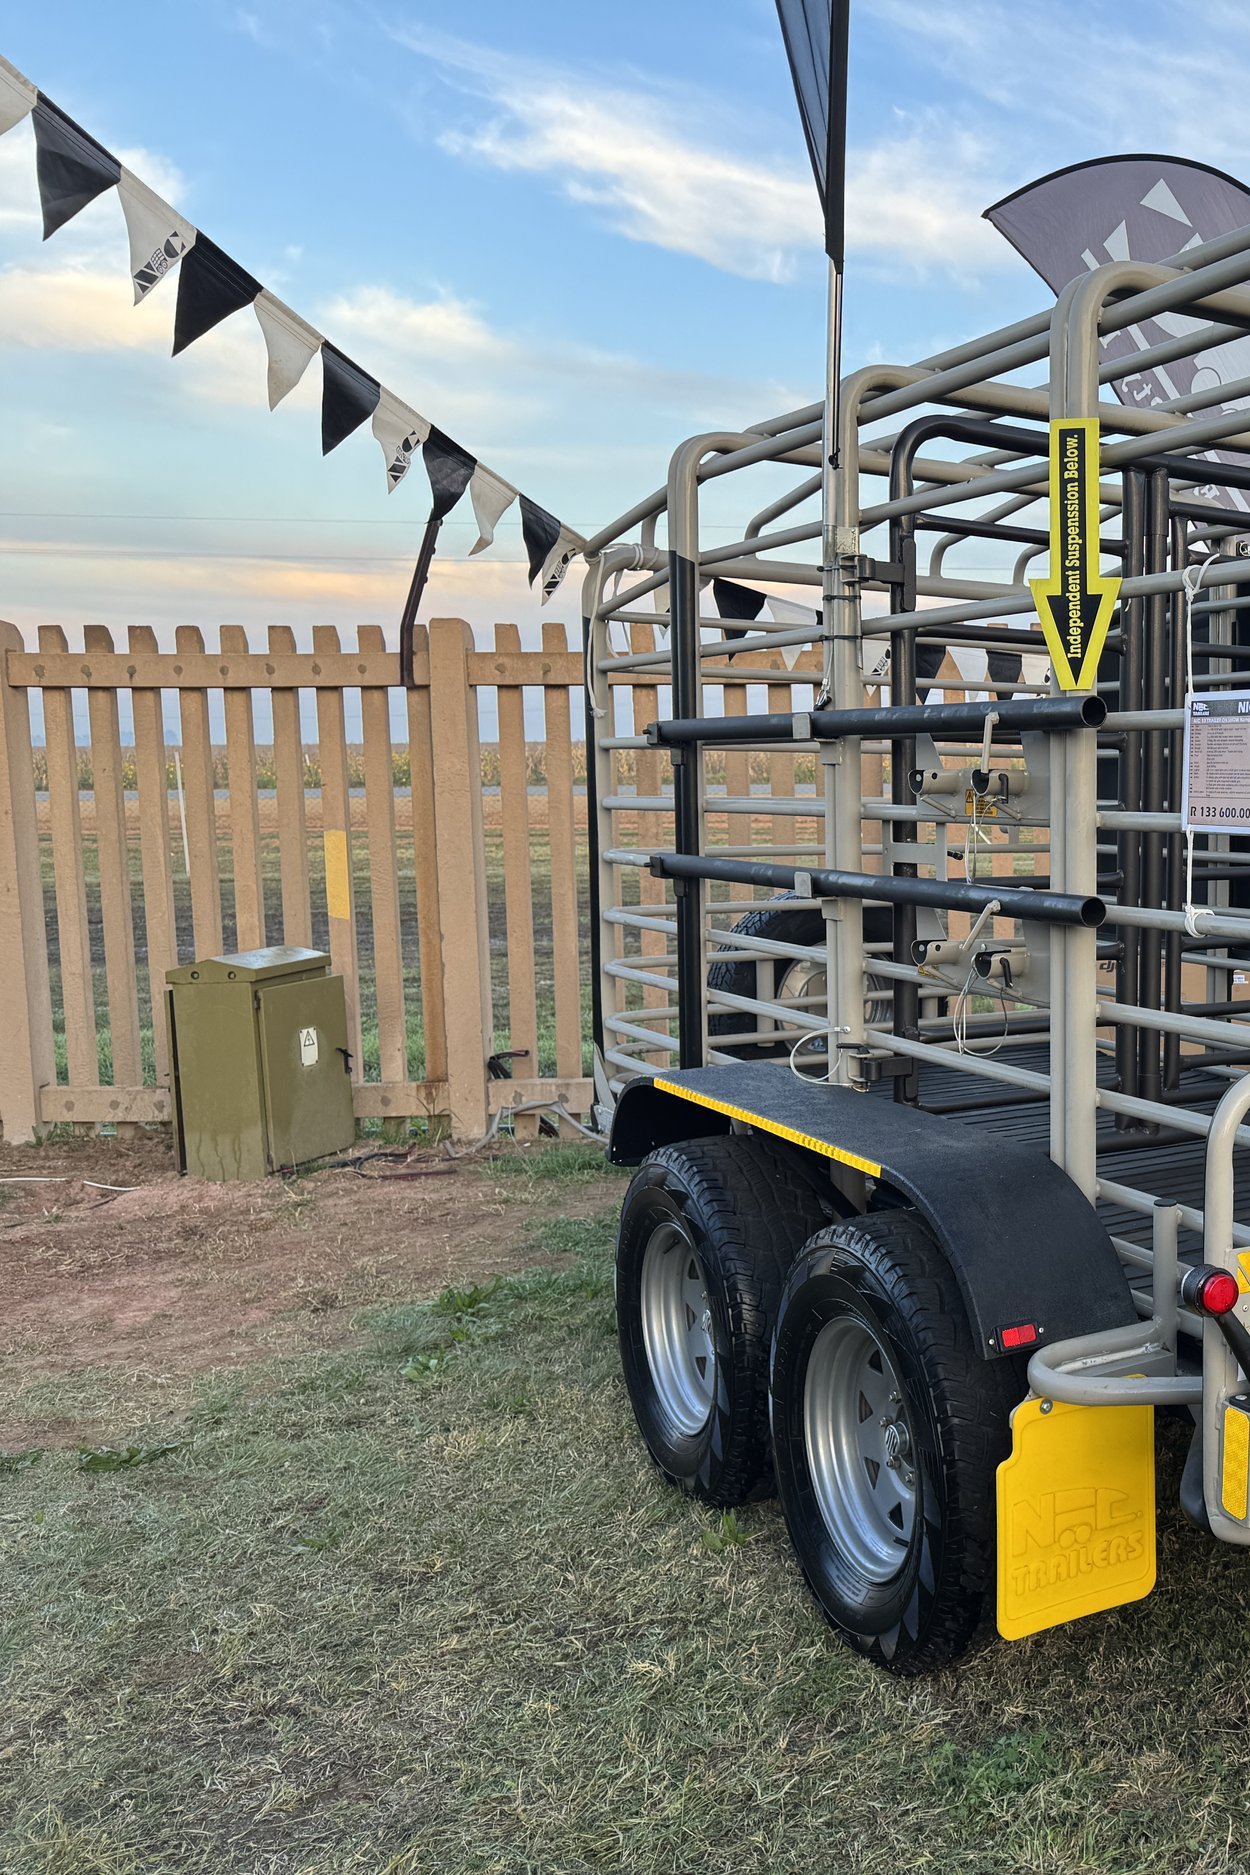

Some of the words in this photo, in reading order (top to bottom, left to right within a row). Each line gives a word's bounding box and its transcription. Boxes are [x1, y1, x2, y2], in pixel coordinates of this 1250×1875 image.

[1063, 434, 1079, 479] Below.
[1067, 569, 1084, 659] Independent
[1190, 806, 1197, 817] R
[1200, 806, 1217, 817] 133
[1218, 807, 1250, 819] 600.00
[1099, 960, 1116, 973] dj
[1011, 1529, 1145, 1597] TRAILERS
